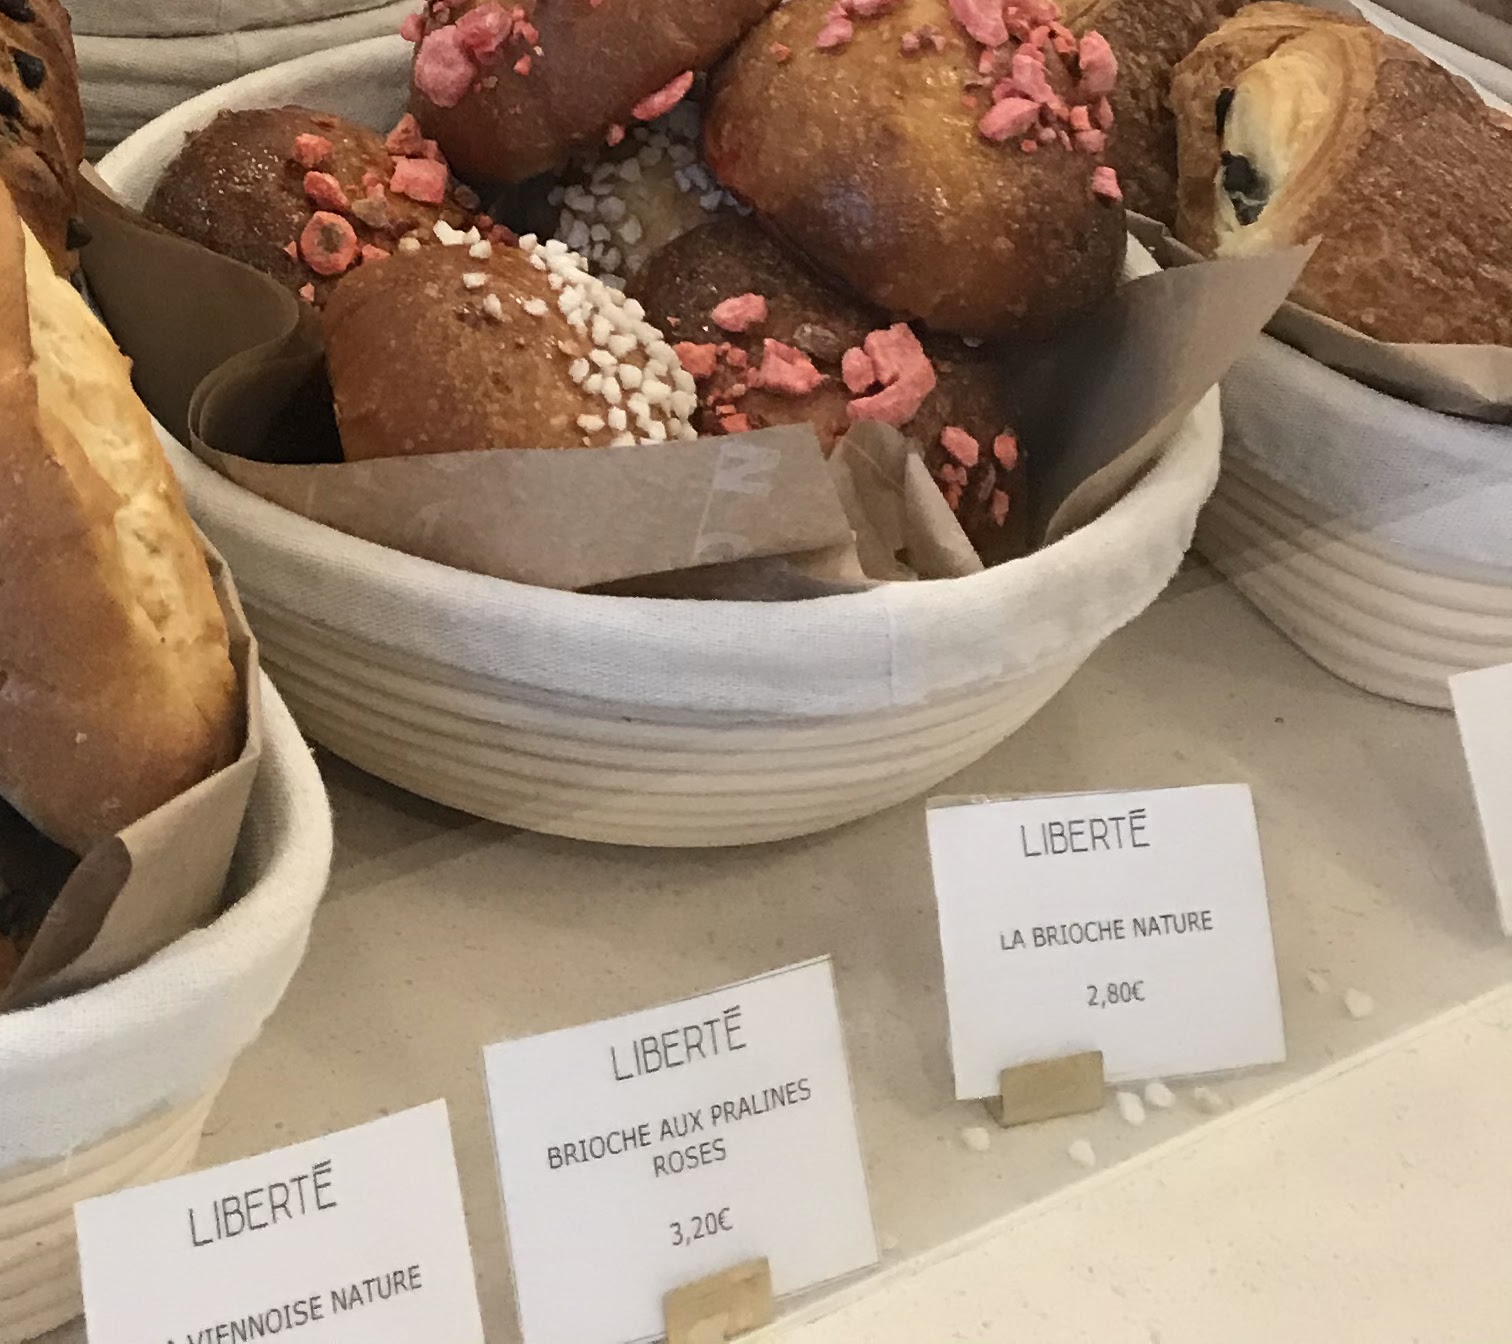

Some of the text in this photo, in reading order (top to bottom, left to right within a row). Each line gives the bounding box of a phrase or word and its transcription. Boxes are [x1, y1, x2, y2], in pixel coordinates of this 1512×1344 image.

[1020, 808, 1151, 857] LIBERTÉ
[999, 910, 1213, 951] LA BRIOCHE NATURE
[1087, 981, 1146, 1009] 2,80€
[610, 1005, 747, 1081] LIBERTÉ
[547, 1078, 812, 1169] BRIOCHE AUX PRALINES
[653, 1138, 727, 1178] ROSES
[189, 1159, 338, 1247] LIBERTÉ
[669, 1207, 734, 1247] 3,20€
[330, 1264, 423, 1314] NATURE
